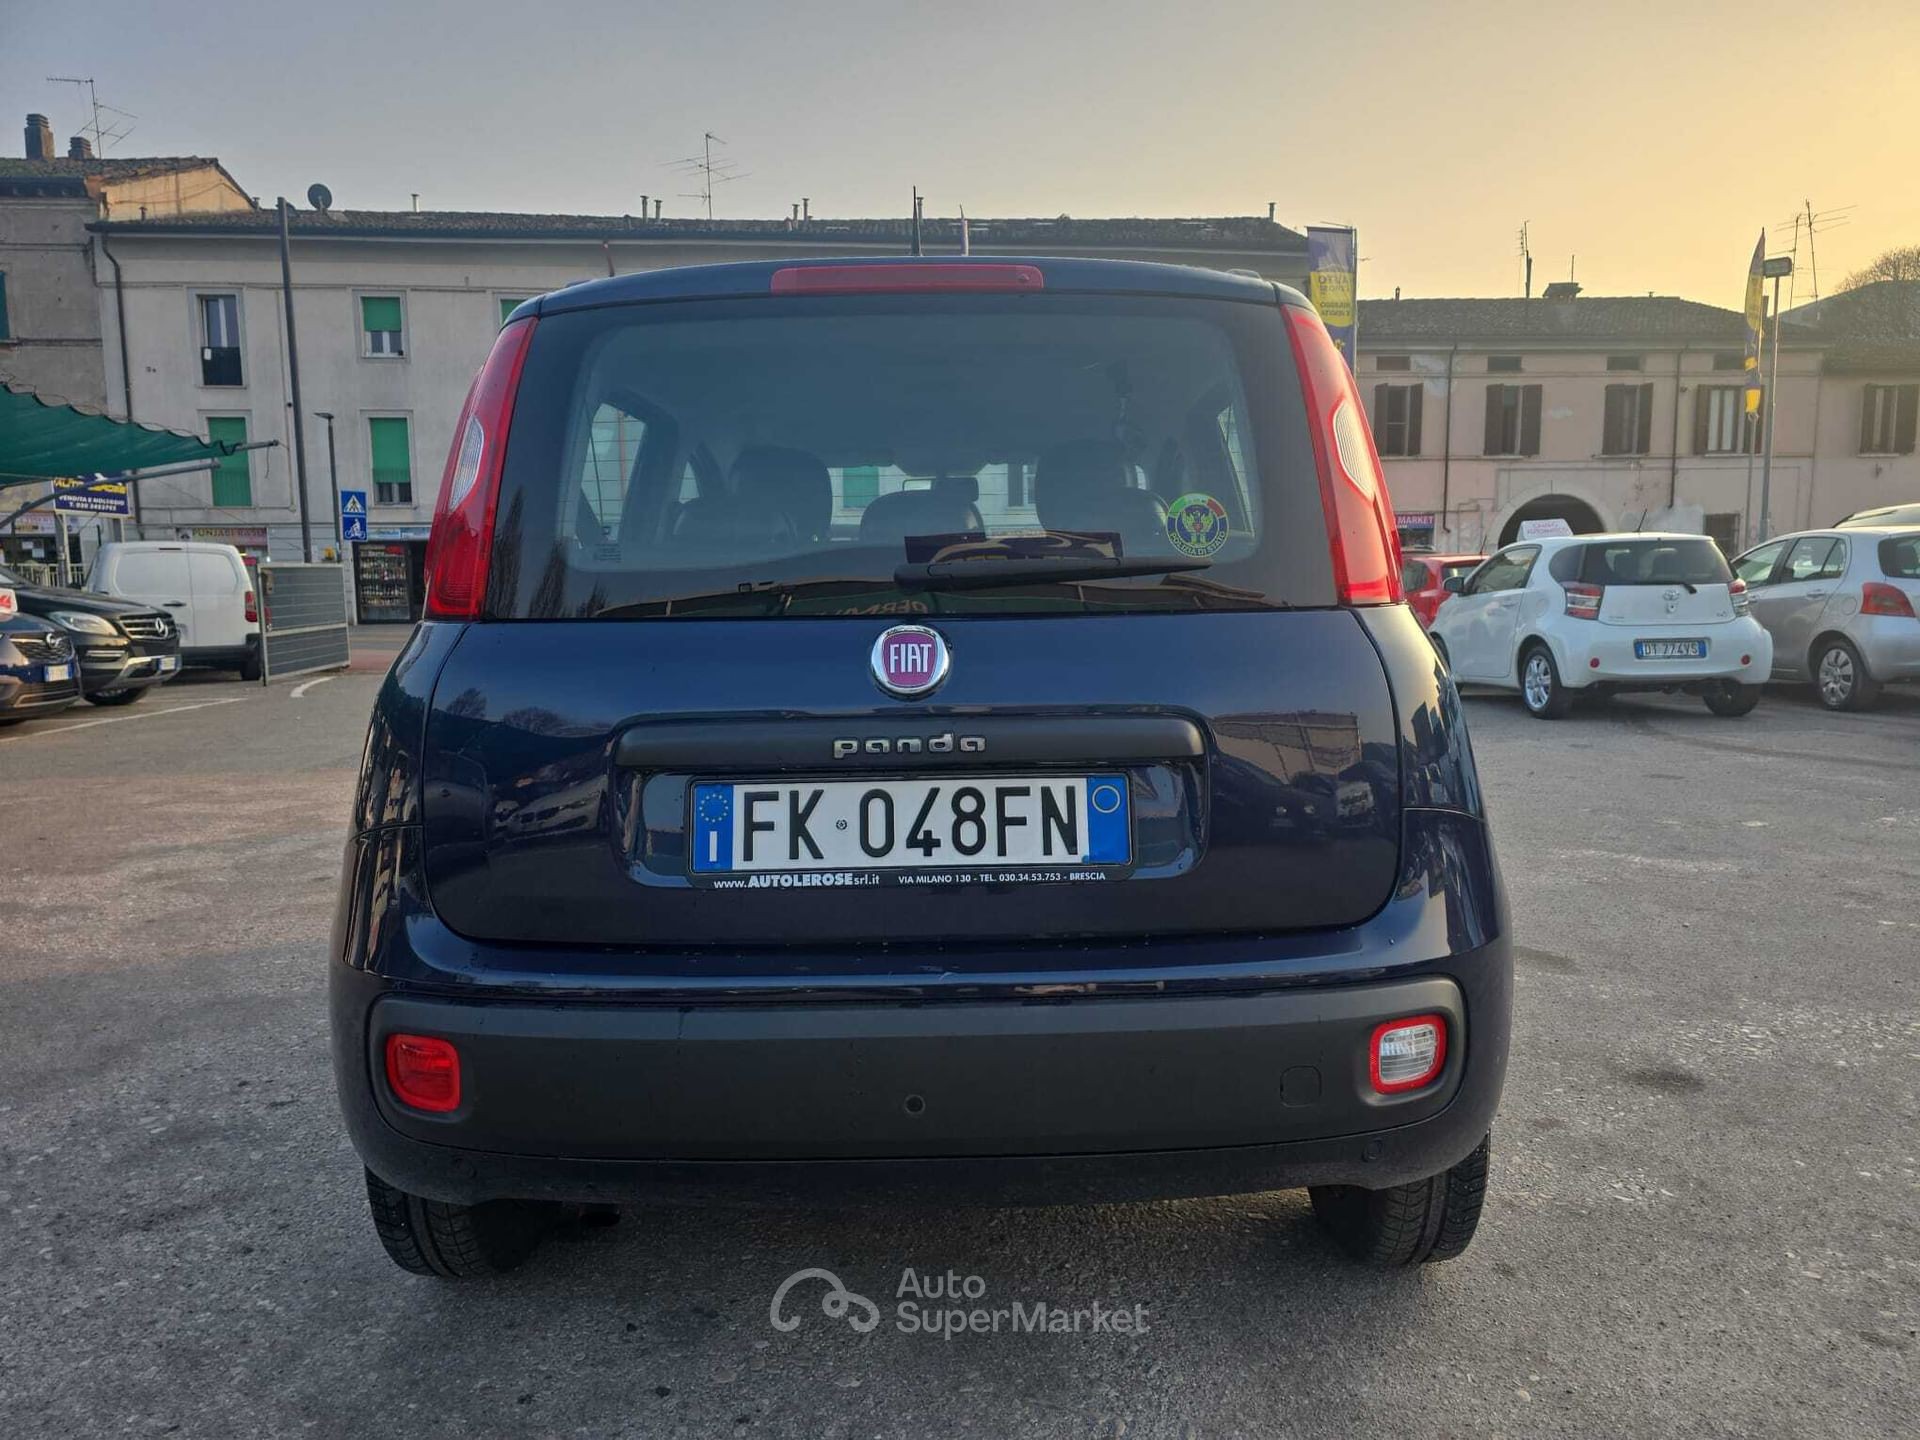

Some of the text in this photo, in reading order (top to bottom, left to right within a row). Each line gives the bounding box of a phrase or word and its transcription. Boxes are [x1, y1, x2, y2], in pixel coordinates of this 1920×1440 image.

[1398, 515, 1434, 524] MARKET
[889, 643, 931, 673] FIAT
[833, 733, 986, 759] panda
[743, 789, 824, 861] FK
[859, 785, 1078, 858] 048FN
[898, 875, 914, 884] VIA
[916, 875, 953, 884] MILANO
[955, 875, 971, 883] 130
[979, 874, 997, 882] TEL.
[999, 873, 1061, 882] 030.34.53.753
[1070, 872, 1106, 881] BRESCIA
